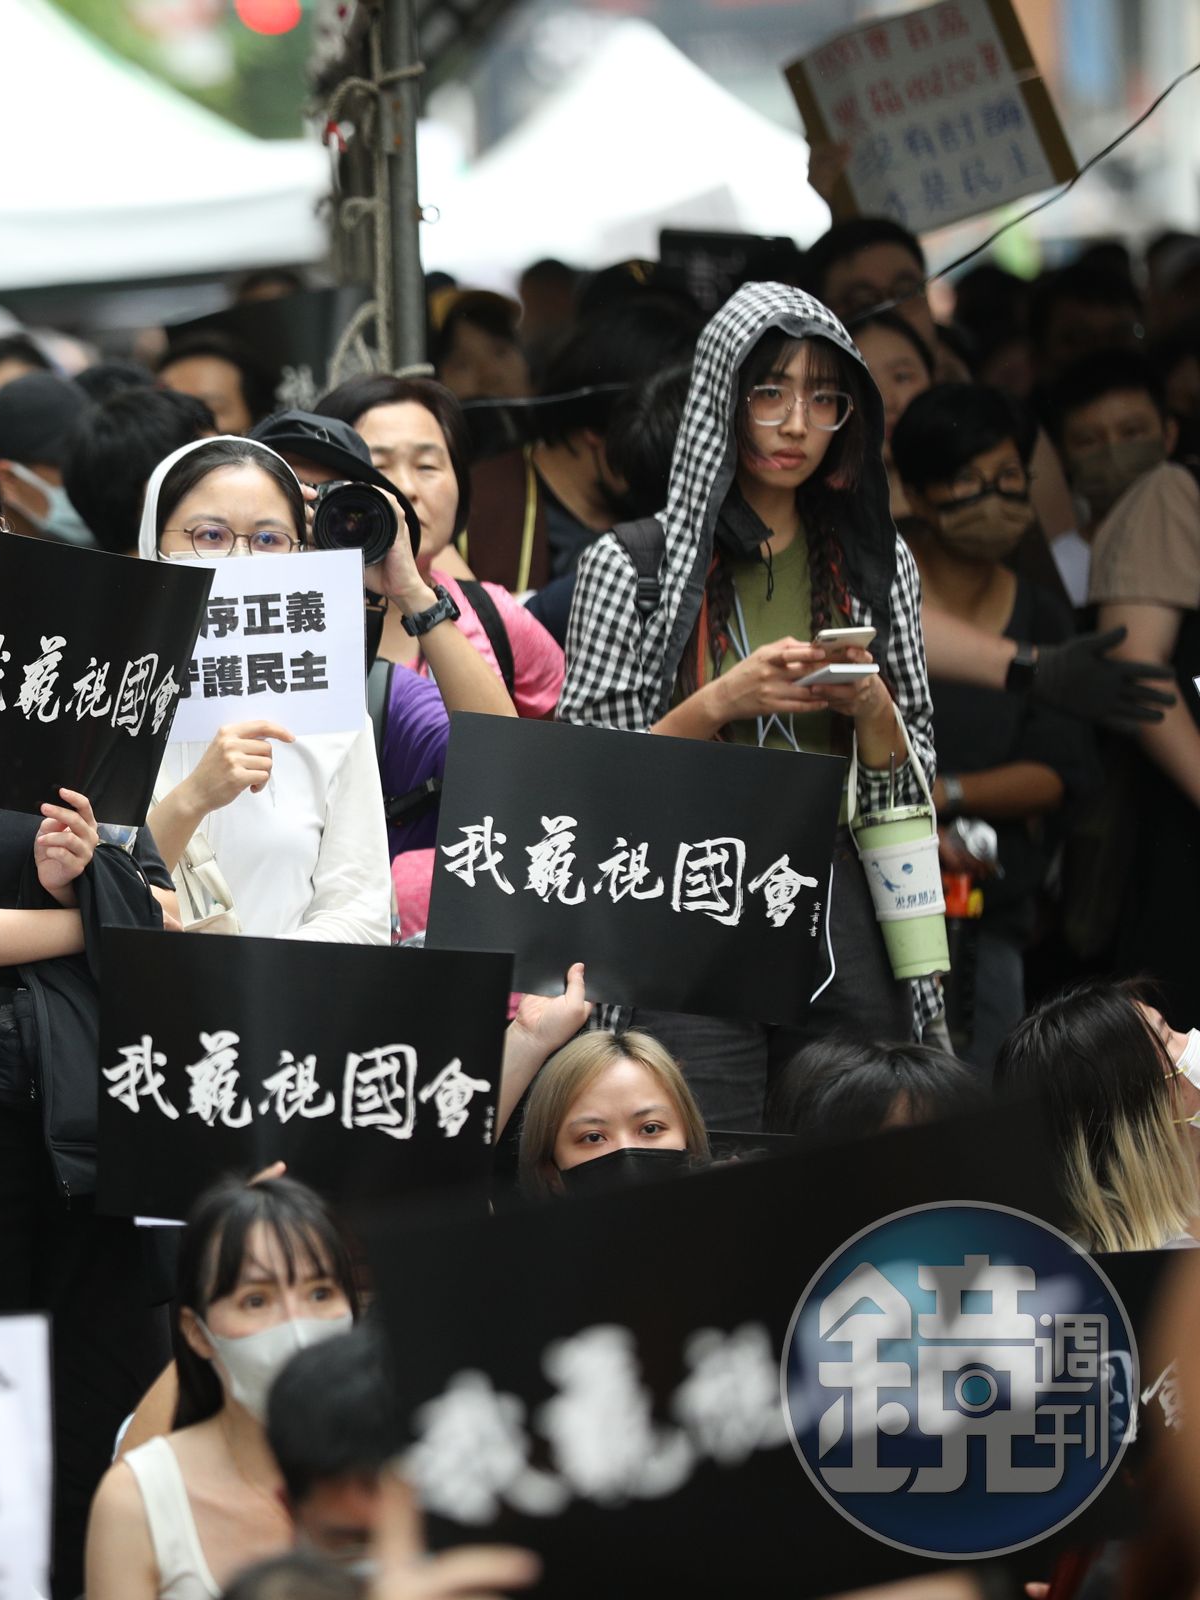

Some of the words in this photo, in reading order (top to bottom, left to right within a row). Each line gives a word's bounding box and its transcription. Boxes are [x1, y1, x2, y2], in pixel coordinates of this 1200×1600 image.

[440, 815, 819, 928] 我藐視國會
[102, 1030, 492, 1139] 我藐視國會
